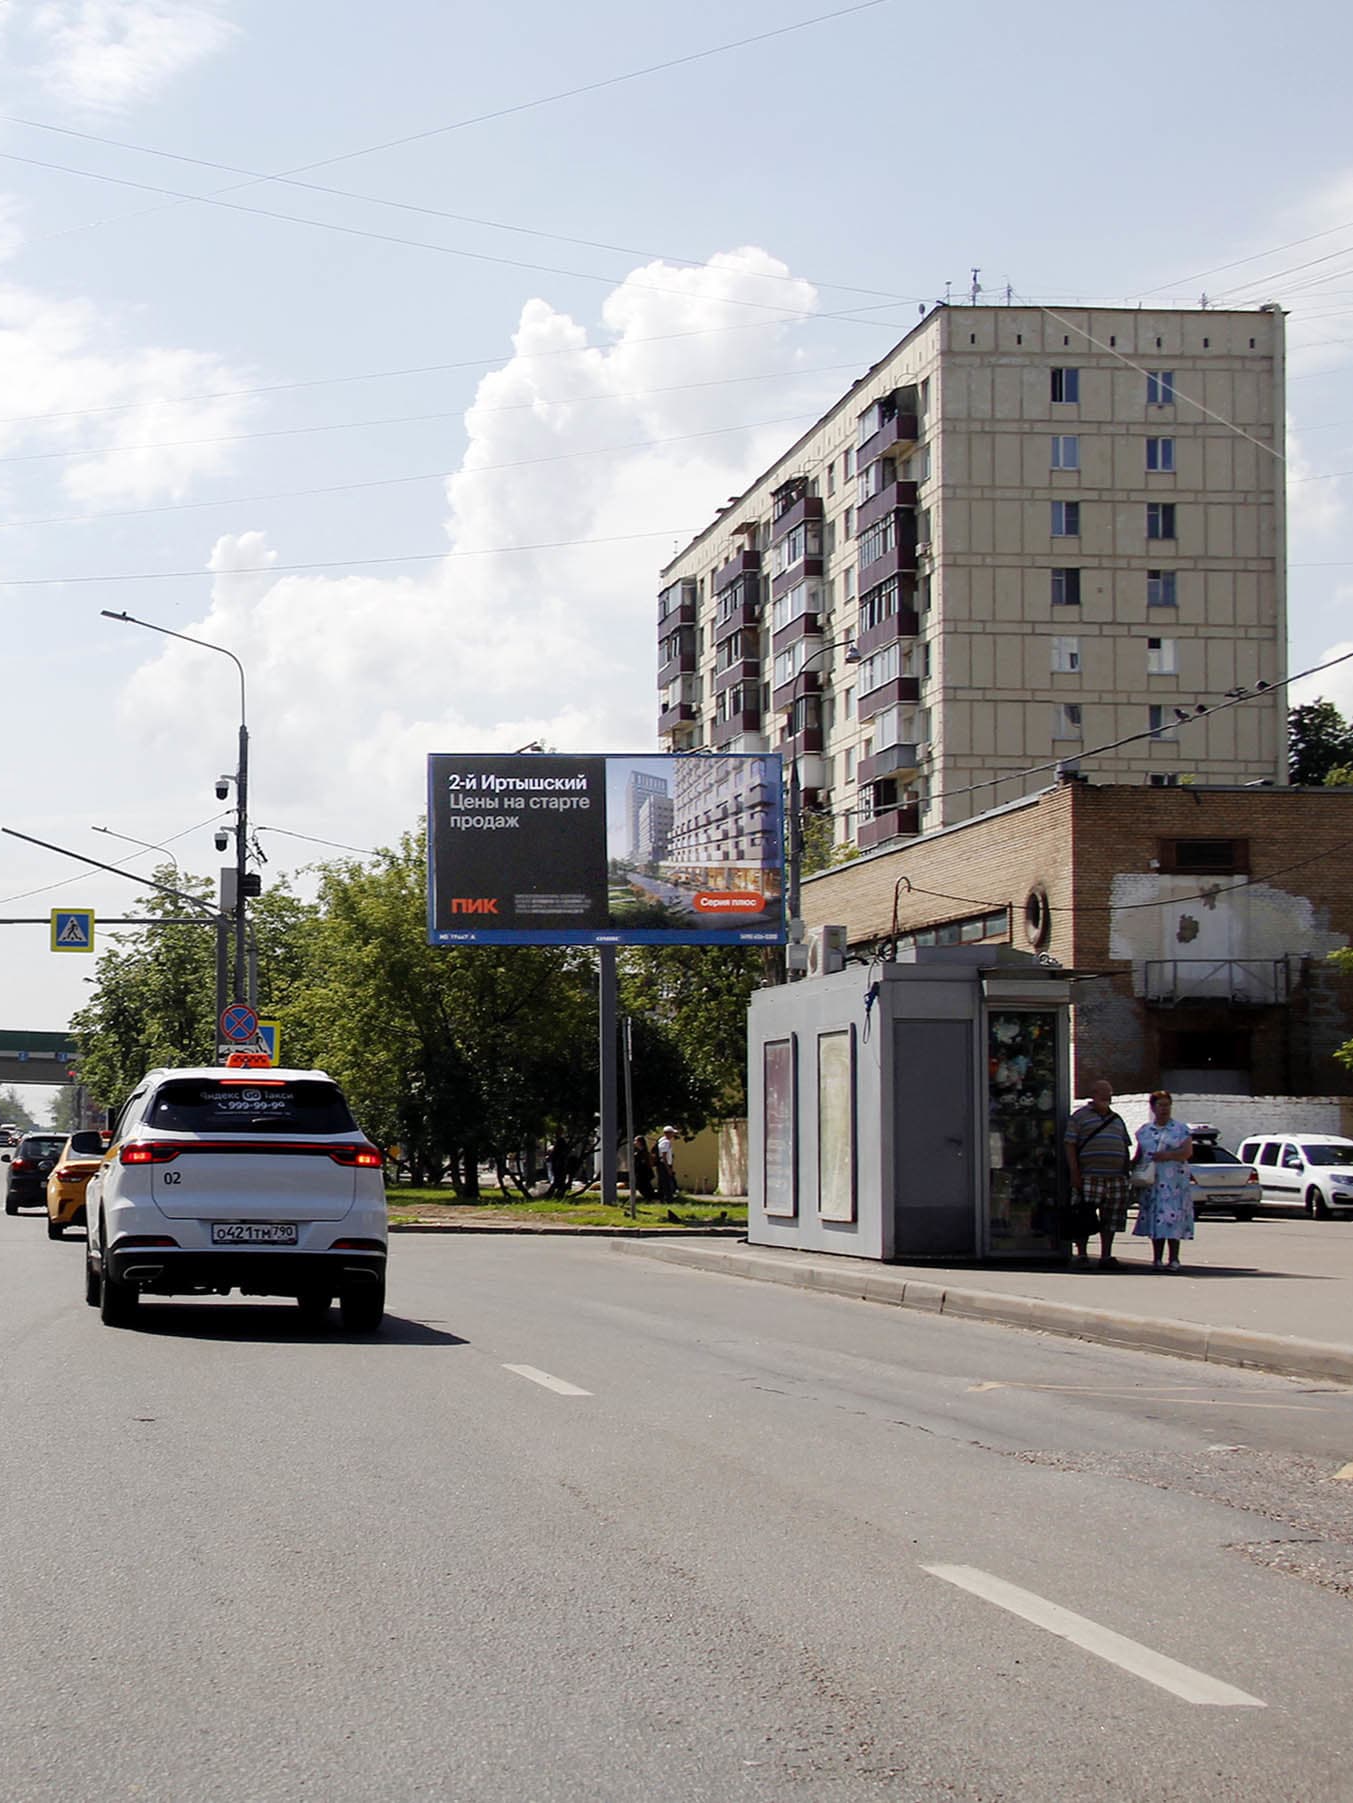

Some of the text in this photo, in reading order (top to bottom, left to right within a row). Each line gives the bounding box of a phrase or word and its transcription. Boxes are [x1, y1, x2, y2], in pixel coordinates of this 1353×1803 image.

[448, 774, 587, 793] 2-й Иртышский
[449, 794, 591, 812] Цены на старте
[450, 815, 520, 831] продаж
[451, 898, 499, 914] ПИК
[700, 897, 757, 907] Серия плюс
[164, 1172, 181, 1185] 02
